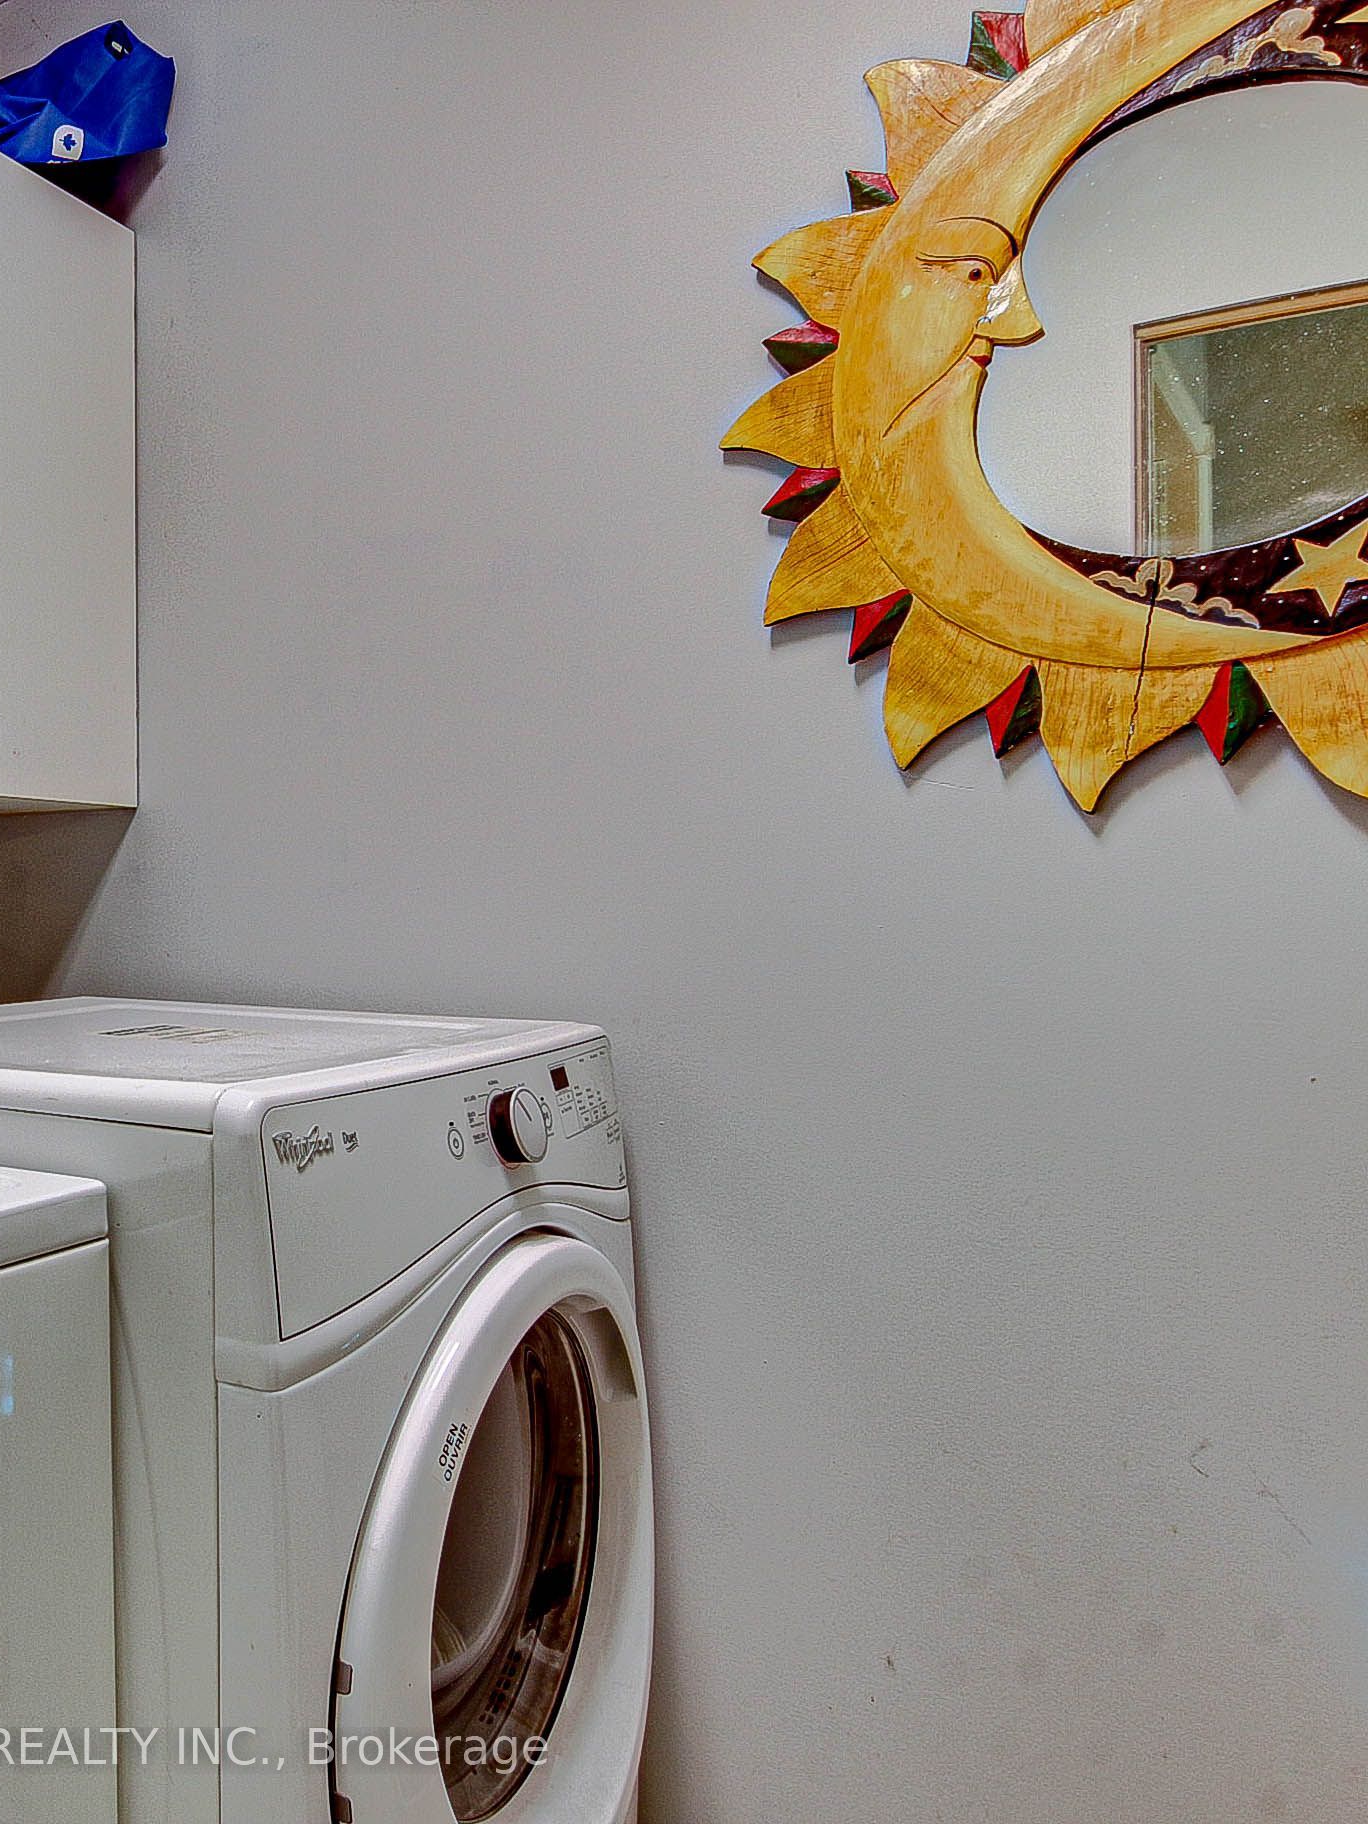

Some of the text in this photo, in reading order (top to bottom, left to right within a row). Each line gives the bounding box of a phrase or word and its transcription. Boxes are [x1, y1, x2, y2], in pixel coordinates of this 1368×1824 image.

[272, 1125, 334, 1172] Whirlpool
[439, 1423, 459, 1466] OPEN
[444, 1423, 468, 1481] OUVRIR
